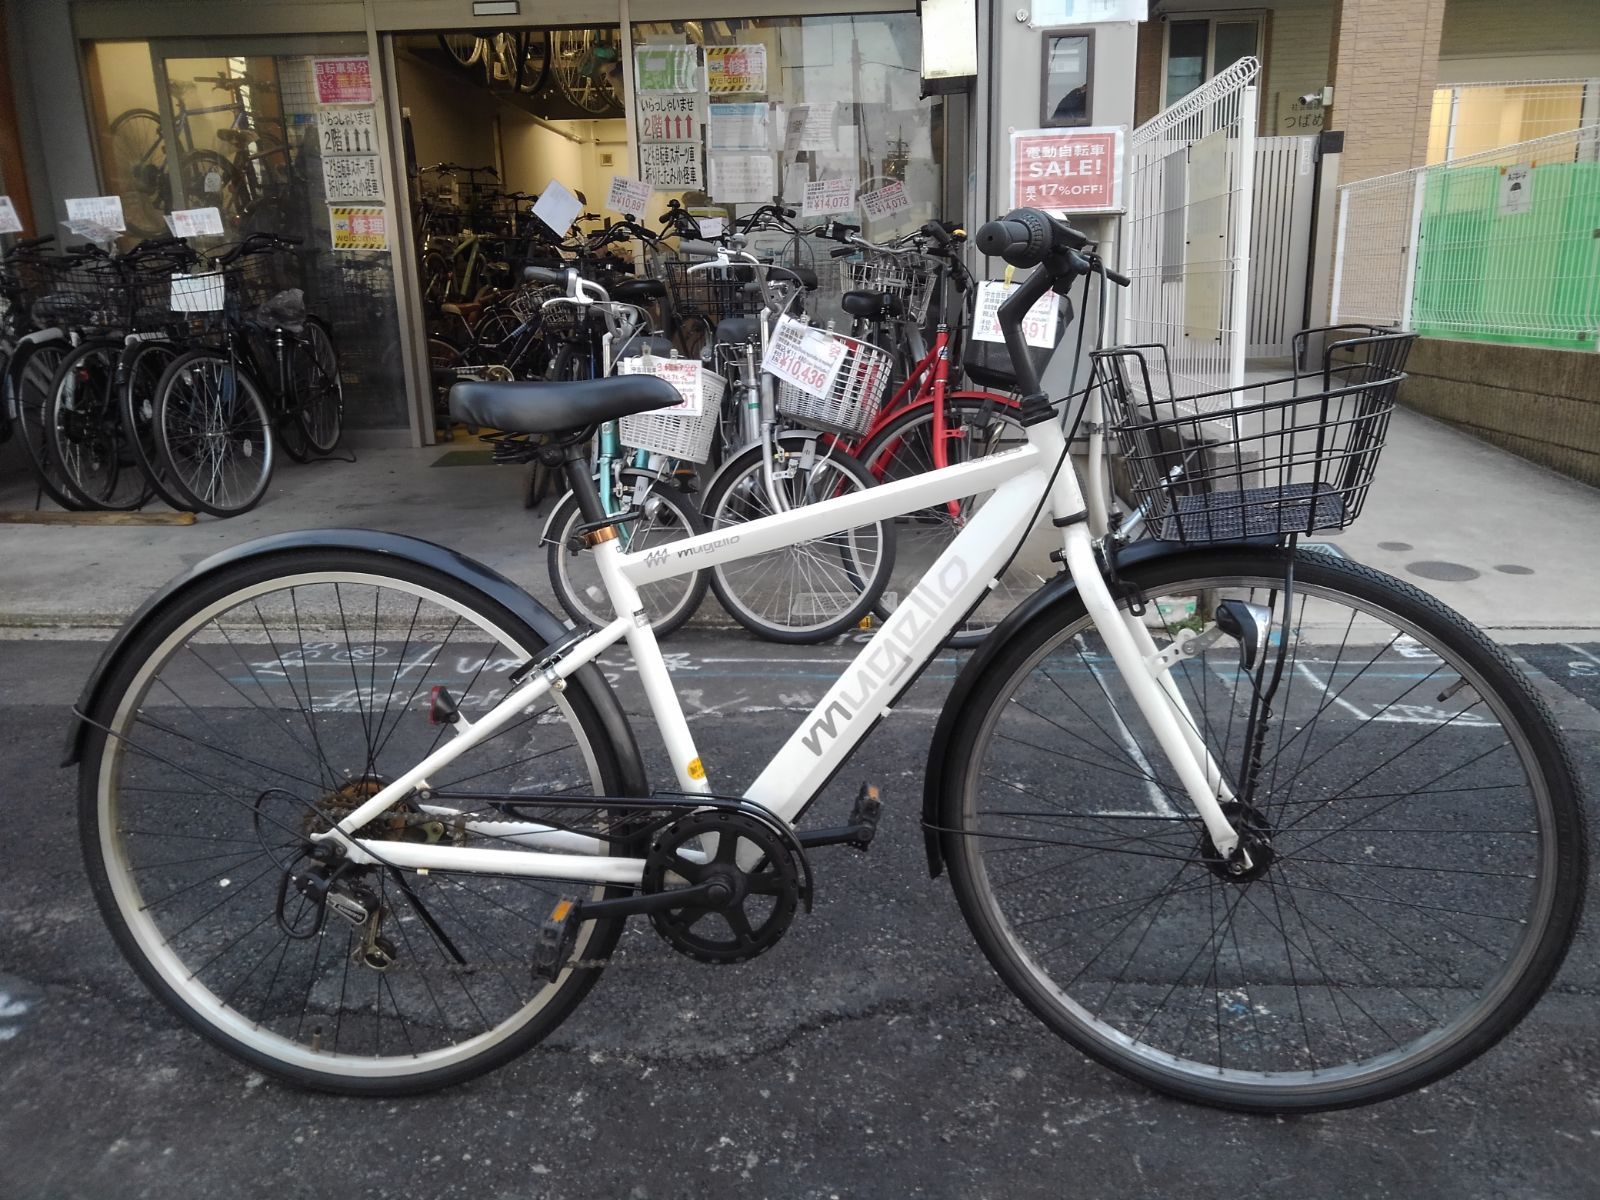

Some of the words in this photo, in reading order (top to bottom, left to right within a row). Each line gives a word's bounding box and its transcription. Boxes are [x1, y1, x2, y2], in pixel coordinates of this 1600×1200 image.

[316, 62, 369, 74] 自転車処分
[640, 97, 694, 112] いらっしゃいませ
[319, 110, 371, 126] いらっしゃいませ
[643, 113, 663, 139] 2階
[1284, 114, 1323, 128] つばめ
[324, 127, 343, 152] 2階
[1025, 144, 1105, 159] 電動自転車
[1028, 159, 1102, 178] SALE!
[1026, 185, 1037, 202] 最大
[1038, 183, 1104, 197] 17%OFF!
[813, 195, 850, 210] ¥14,073
[776, 352, 828, 390] ¥10,436
